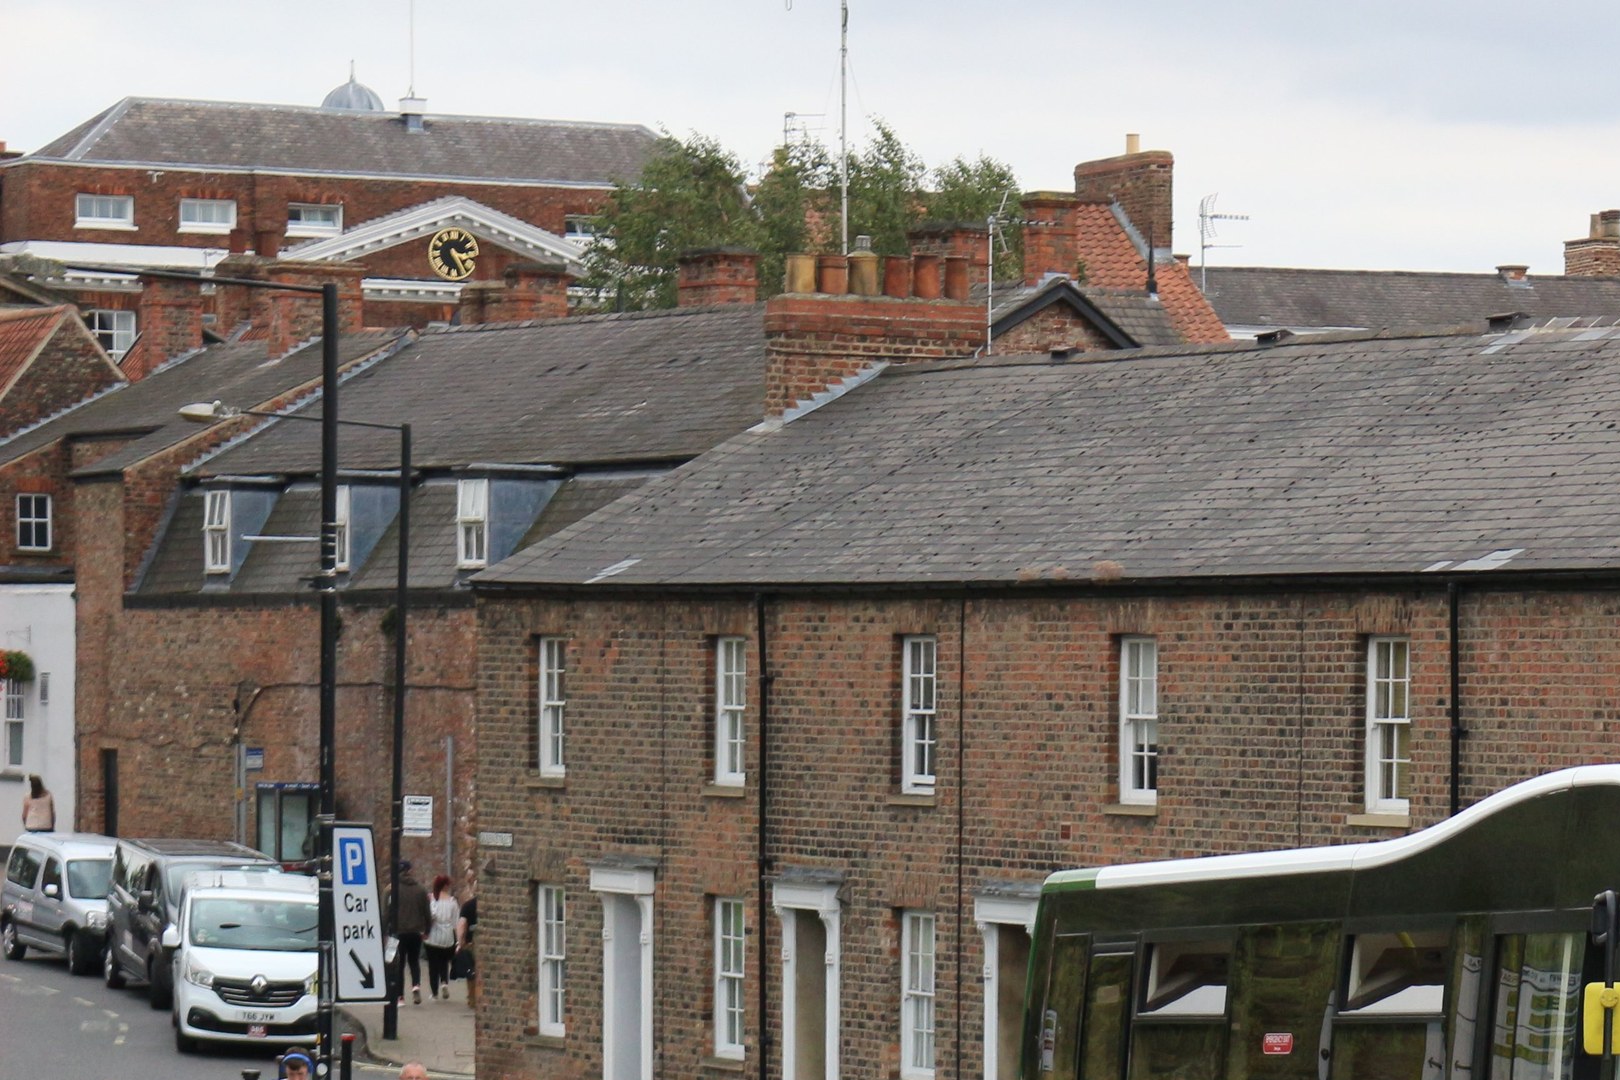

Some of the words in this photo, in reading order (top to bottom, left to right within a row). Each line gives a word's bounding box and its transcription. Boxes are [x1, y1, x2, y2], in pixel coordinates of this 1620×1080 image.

[345, 842, 363, 881] P
[344, 892, 369, 913] Car
[343, 919, 376, 944] park
